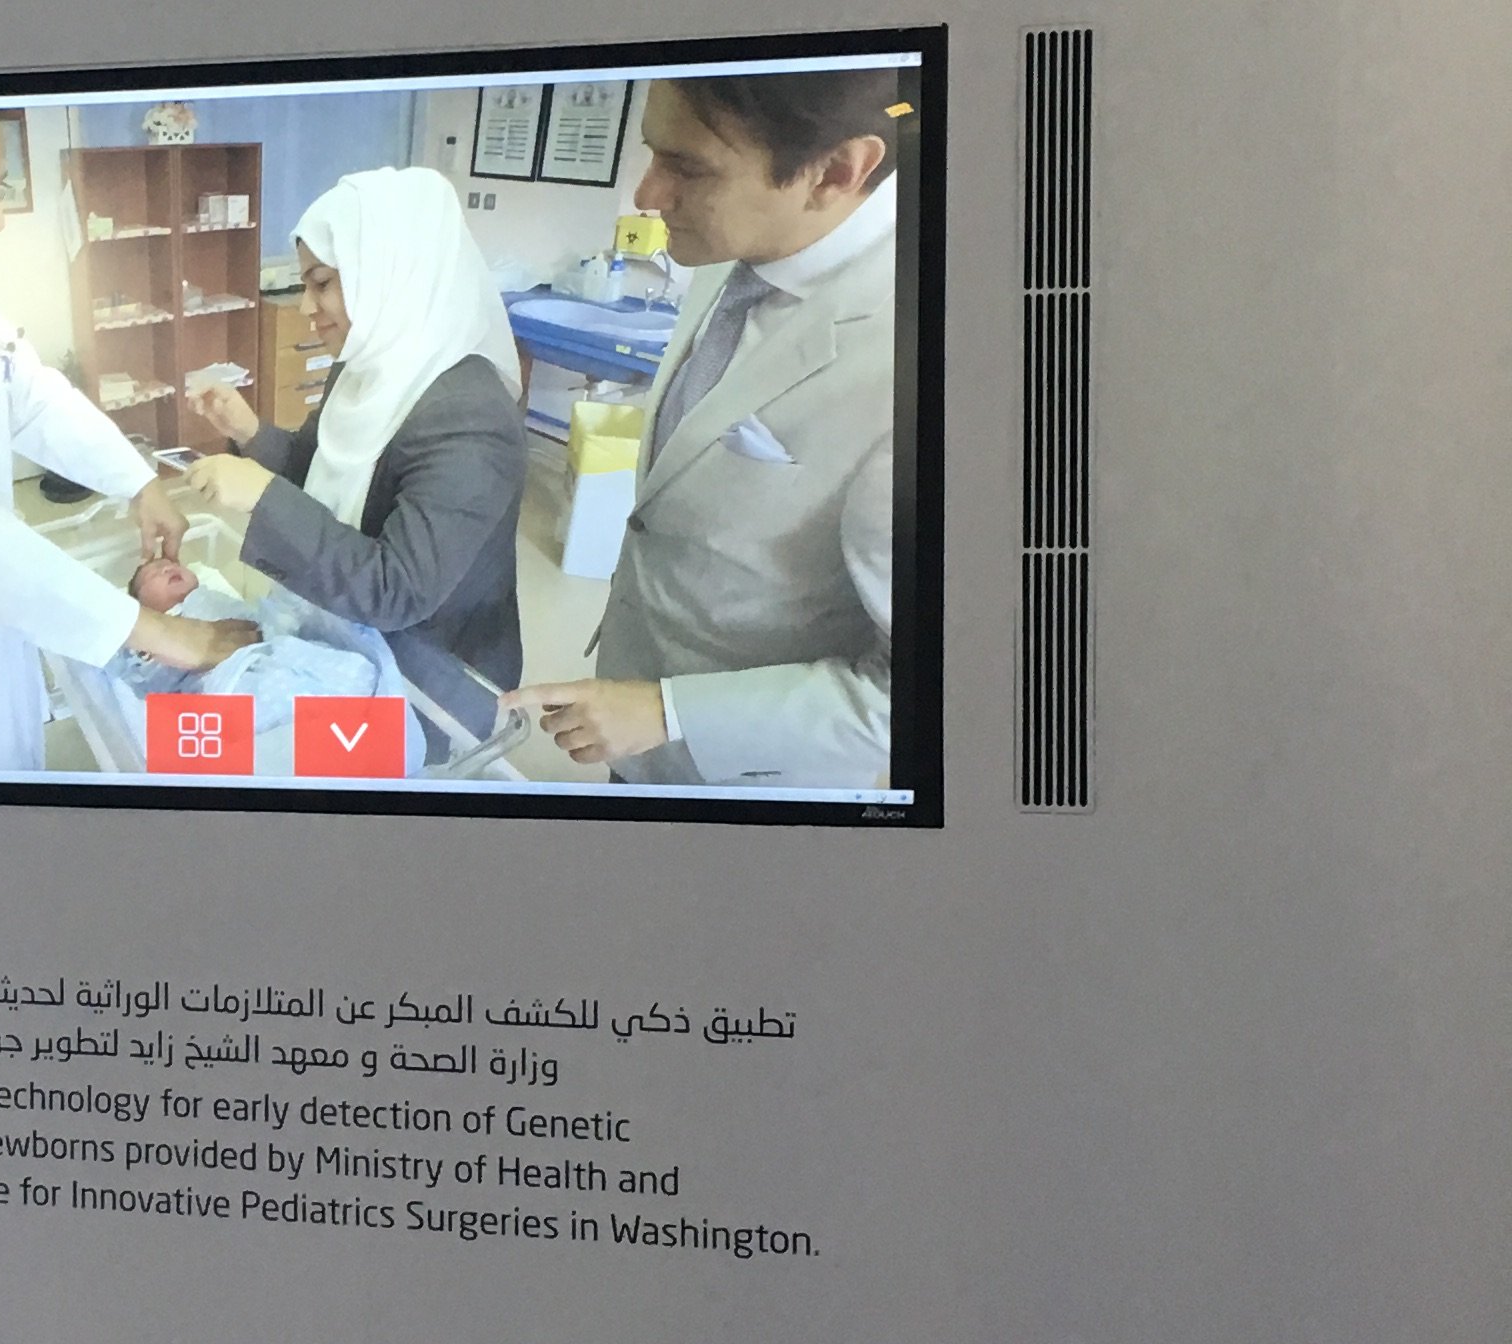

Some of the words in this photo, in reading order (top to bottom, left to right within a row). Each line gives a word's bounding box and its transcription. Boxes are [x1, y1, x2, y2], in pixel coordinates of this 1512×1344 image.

[76, 979, 168, 1019] الوراثية
[181, 984, 323, 1022] المتلازمات
[336, 996, 375, 1025] عن
[384, 992, 472, 1029] المبكر
[485, 998, 598, 1029] للكشف
[611, 1002, 690, 1043] ذكي
[703, 1007, 796, 1044] تطبيق
[30, 1026, 118, 1062] لتطوير
[130, 1030, 173, 1068] زايد
[185, 1034, 259, 1070] الشيخ
[272, 1046, 349, 1075] معهد
[390, 1044, 476, 1074] الصحة
[361, 1050, 377, 1078] و
[490, 1047, 558, 1086] وزارة
[160, 1088, 203, 1118] for
[213, 1093, 289, 1130] early
[300, 1096, 452, 1132] detection
[463, 1105, 496, 1135] of
[506, 1106, 630, 1142] Genetic
[126, 1139, 256, 1172] provided
[268, 1143, 305, 1180] by
[317, 1146, 443, 1188] Ministry
[455, 1154, 487, 1184] of
[499, 1156, 607, 1191] Health
[618, 1166, 679, 1196] and
[19, 1176, 61, 1207] for
[72, 1180, 230, 1218] Innovative
[242, 1190, 395, 1228] Pediatrics
[406, 1201, 559, 1241] Surgeries
[571, 1210, 598, 1241] in
[610, 1213, 819, 1259] Washington.
